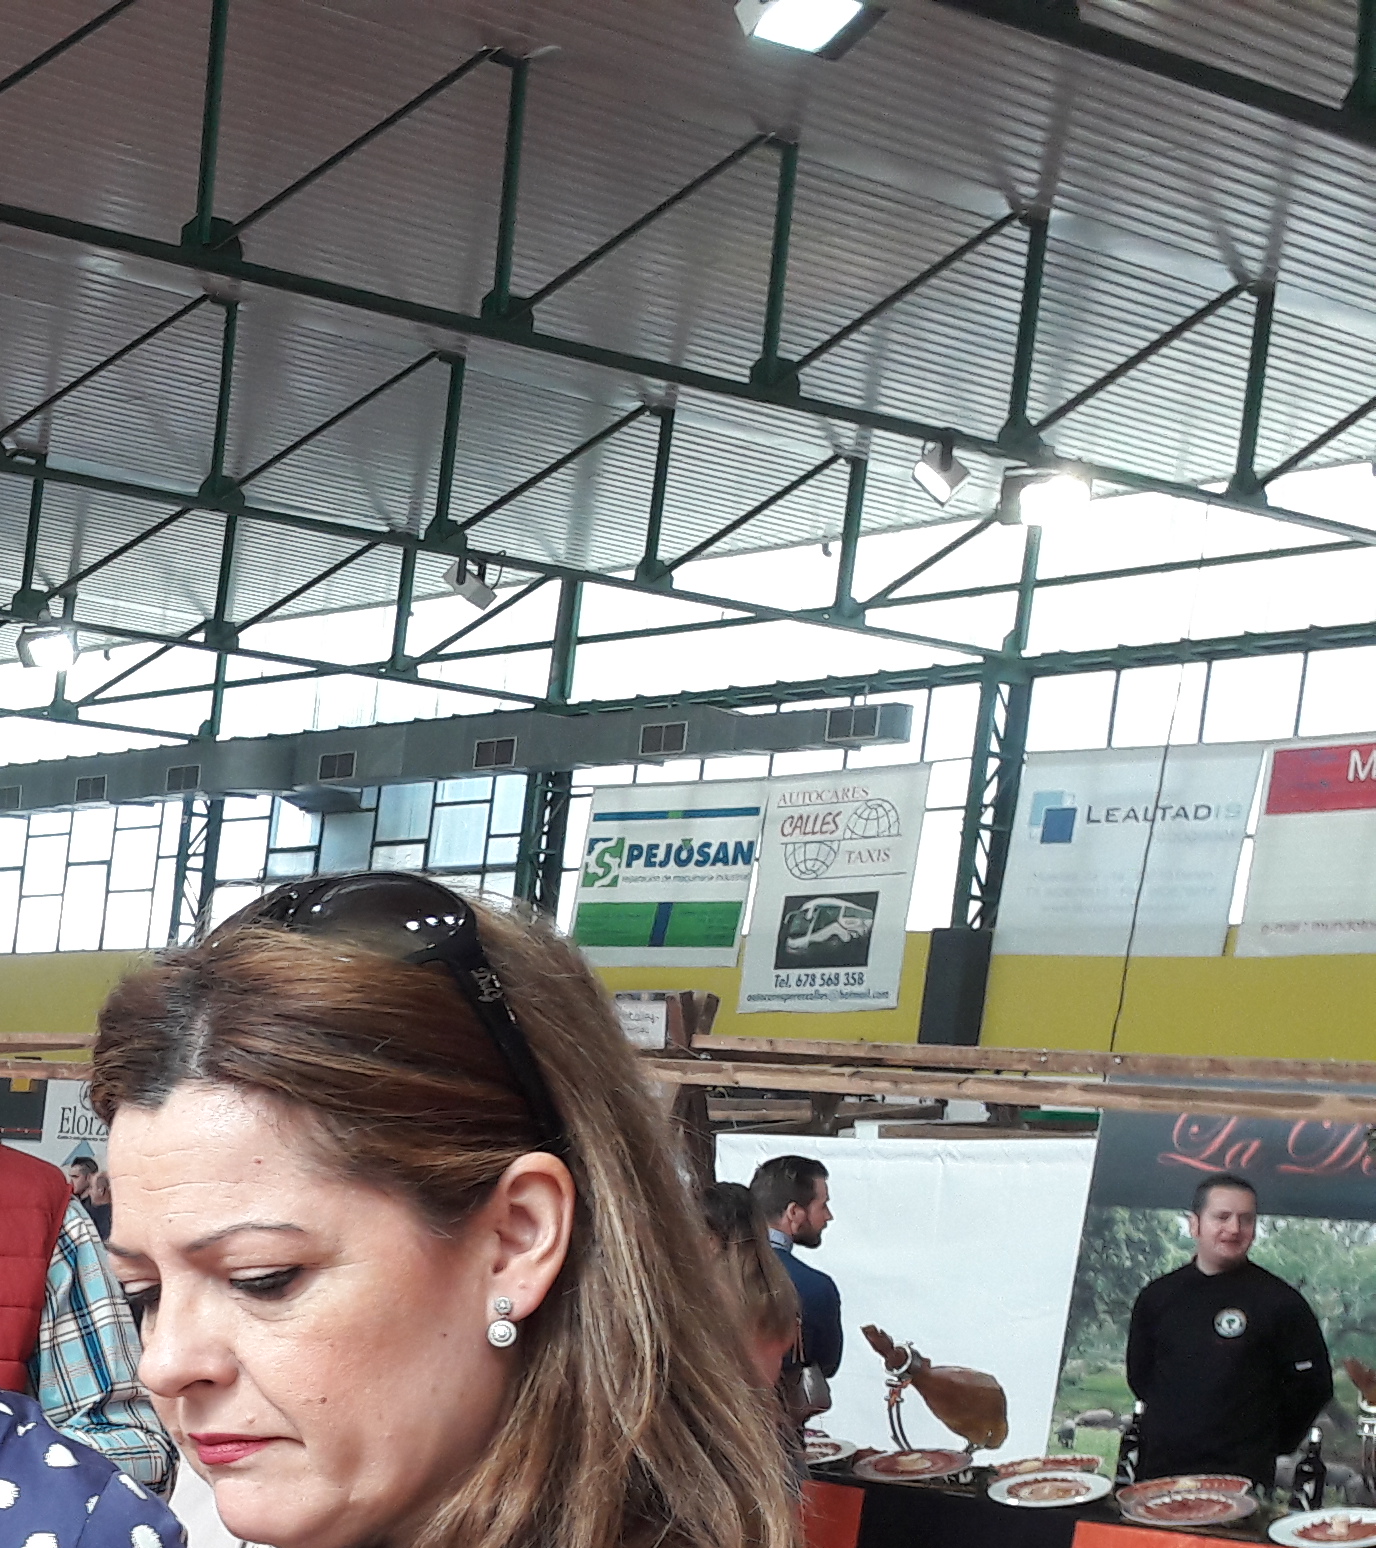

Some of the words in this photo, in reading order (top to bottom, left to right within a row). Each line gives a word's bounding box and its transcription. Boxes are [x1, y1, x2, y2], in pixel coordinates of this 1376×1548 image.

[778, 786, 869, 805] AUTOCARES
[781, 811, 843, 837] CALLES
[845, 848, 891, 865] TAXIS
[774, 973, 792, 988] Tel.
[795, 972, 817, 987] 678
[819, 972, 841, 987] 568
[843, 971, 865, 986] 358
[58, 1105, 109, 1135] Elorz
